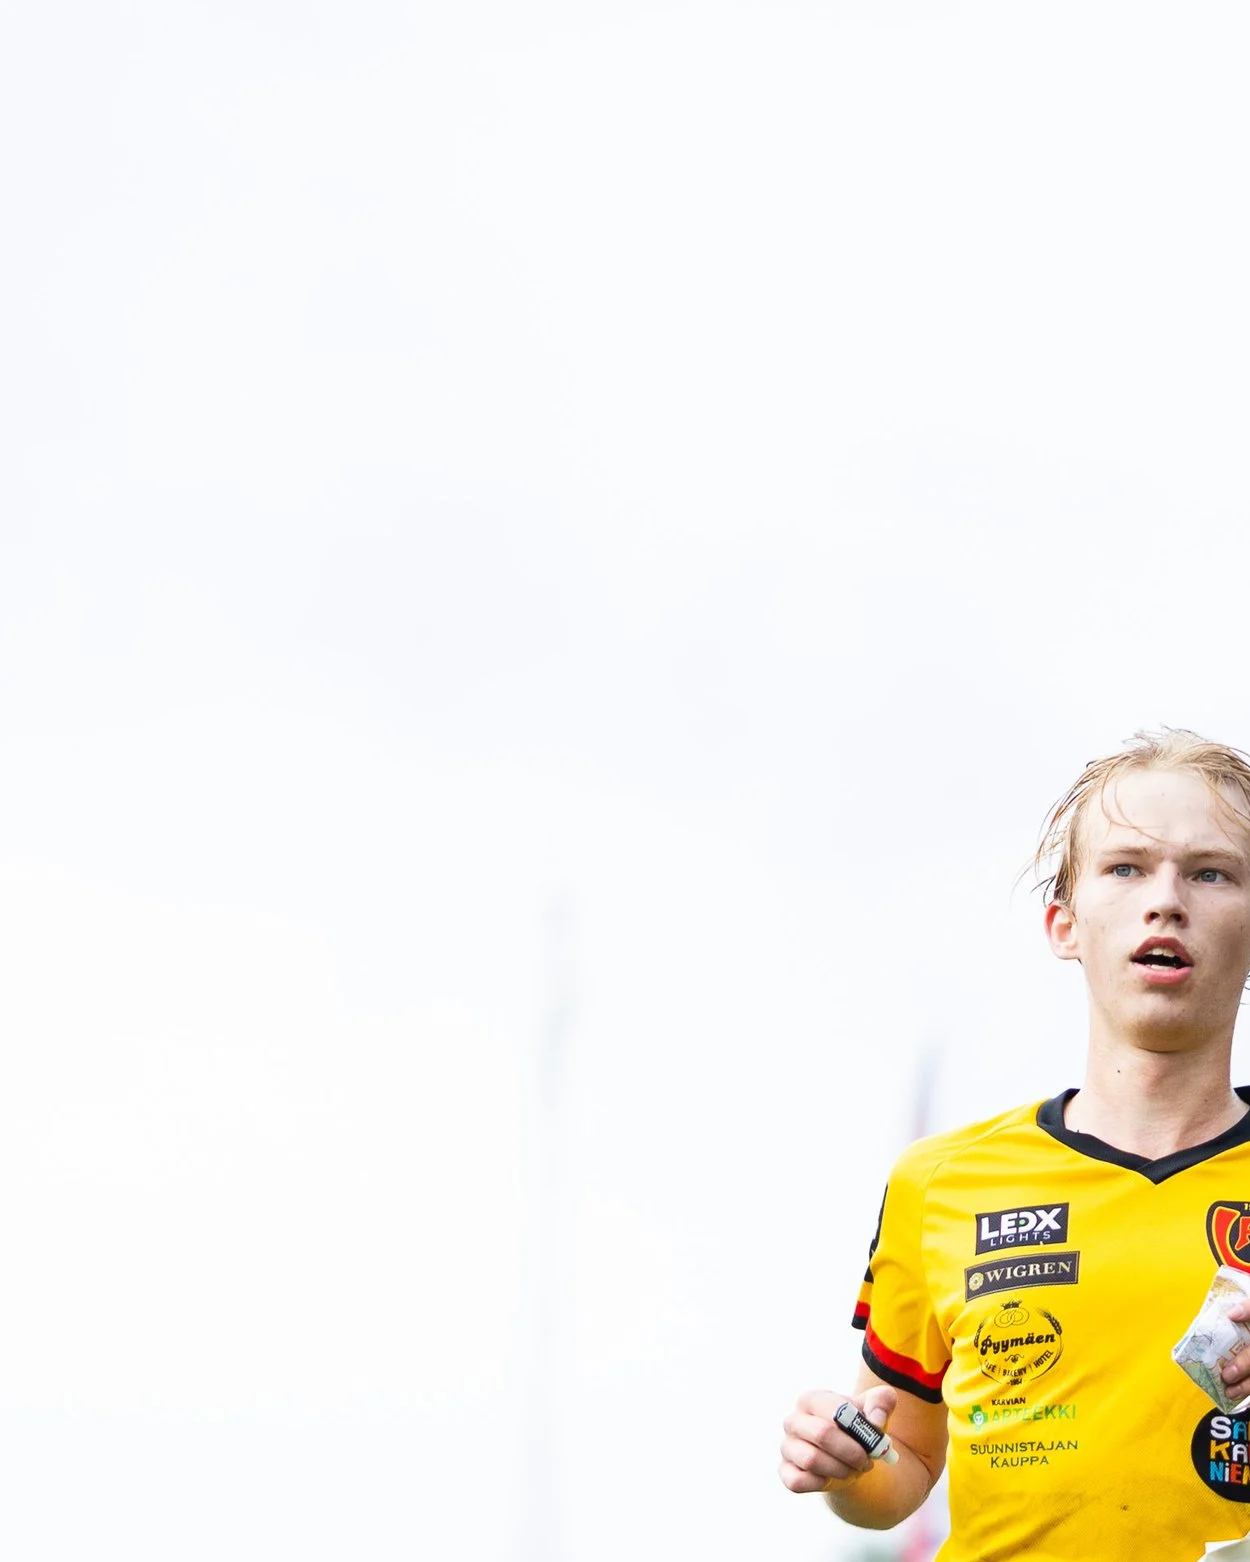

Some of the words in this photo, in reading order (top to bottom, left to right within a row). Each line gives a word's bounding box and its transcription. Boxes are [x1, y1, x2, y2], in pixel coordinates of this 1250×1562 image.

[981, 1208, 1062, 1241] LEDX
[990, 1230, 1051, 1247] LIGHTS
[985, 1260, 1073, 1283] WIGREN
[980, 1333, 1056, 1356] Pyymäen
[1033, 1349, 1055, 1369] HOTEL
[992, 1404, 1077, 1421] APTEEKKI
[970, 1440, 1079, 1455] SUUNNISTAJAN
[990, 1456, 1050, 1468] KAUPPA
